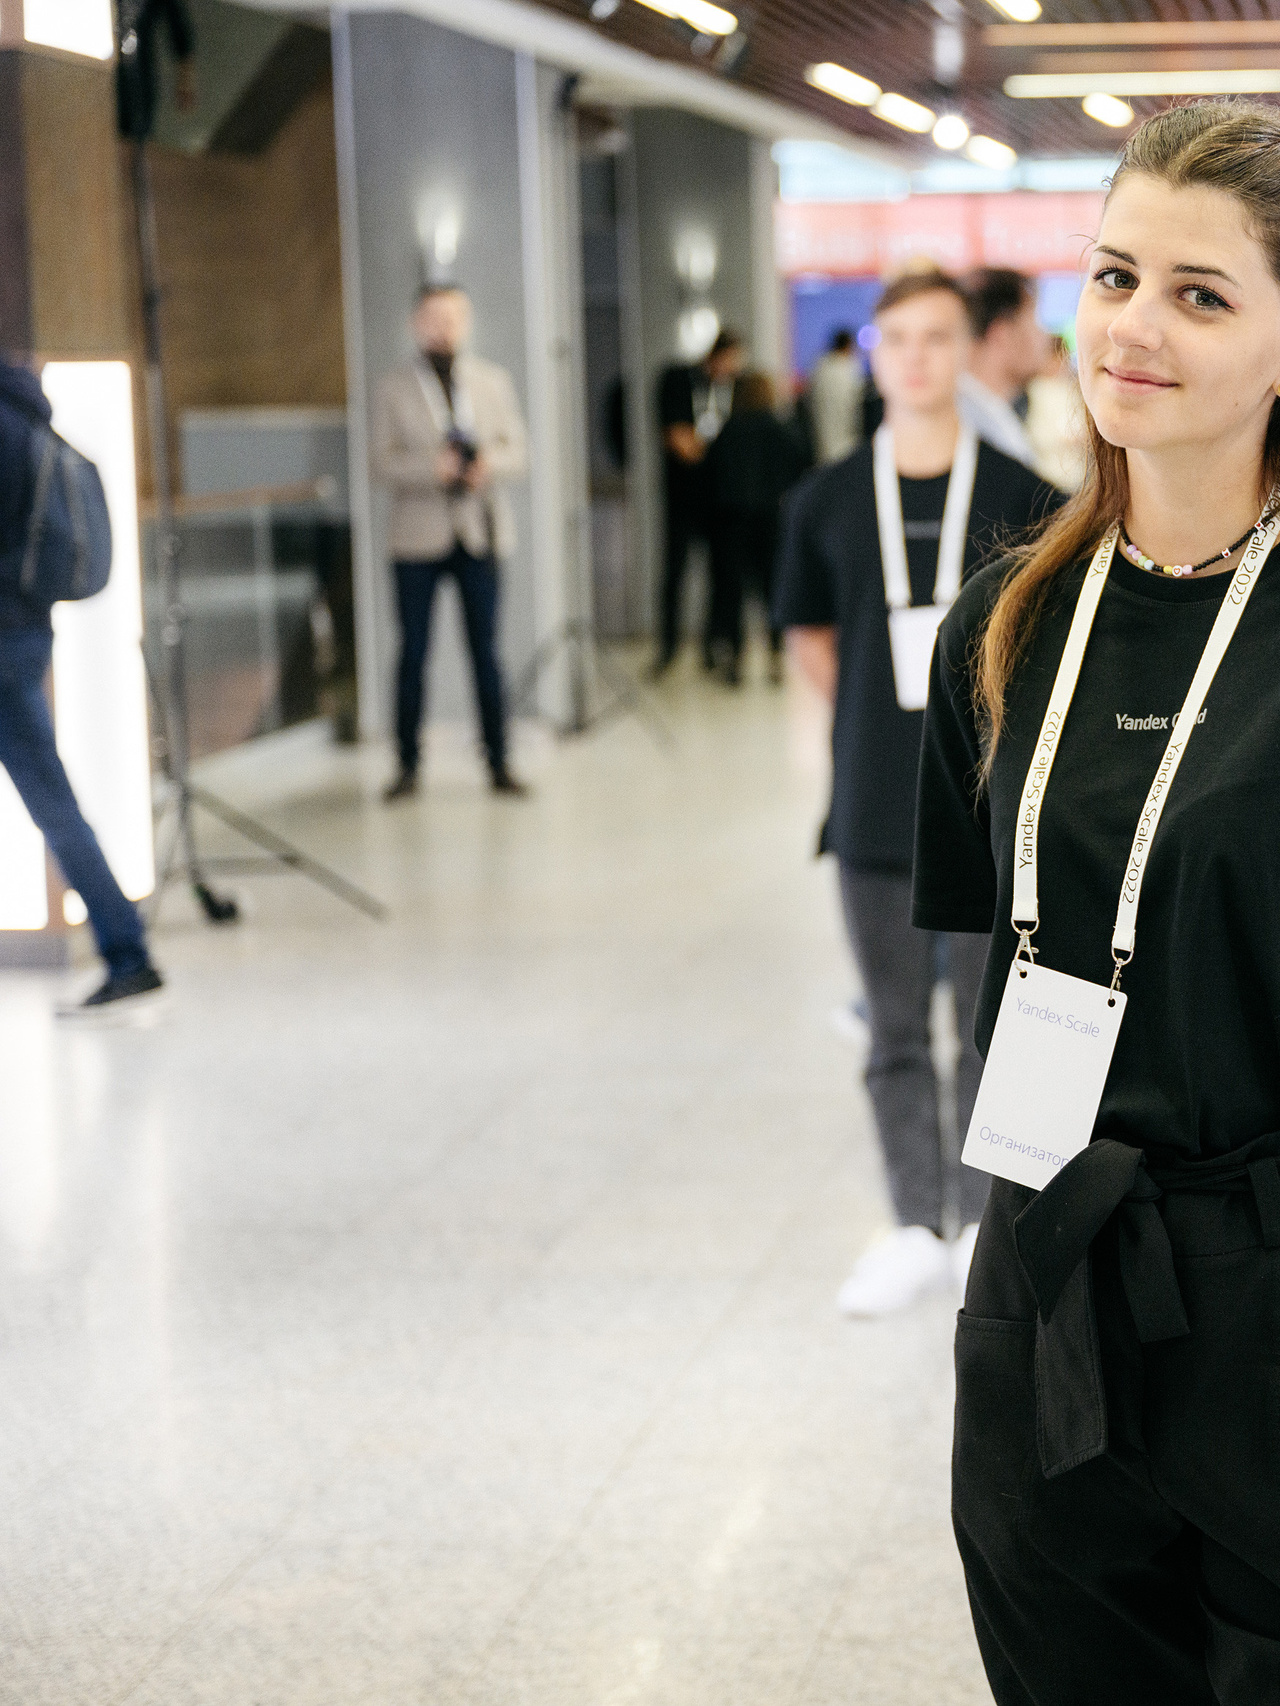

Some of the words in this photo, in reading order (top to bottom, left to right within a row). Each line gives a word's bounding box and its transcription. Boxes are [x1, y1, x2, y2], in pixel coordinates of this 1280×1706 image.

[1227, 563, 1256, 605] 2022
[1039, 710, 1063, 752] 2022
[1115, 713, 1169, 731] Yandex
[1026, 756, 1050, 800] Scale
[1149, 742, 1183, 803] Yandex
[1018, 803, 1037, 869] Yandex
[1134, 806, 1157, 853] Scale
[1121, 857, 1143, 904] 2022
[1017, 997, 1063, 1026] Yandex
[1064, 1014, 1100, 1038] Scale
